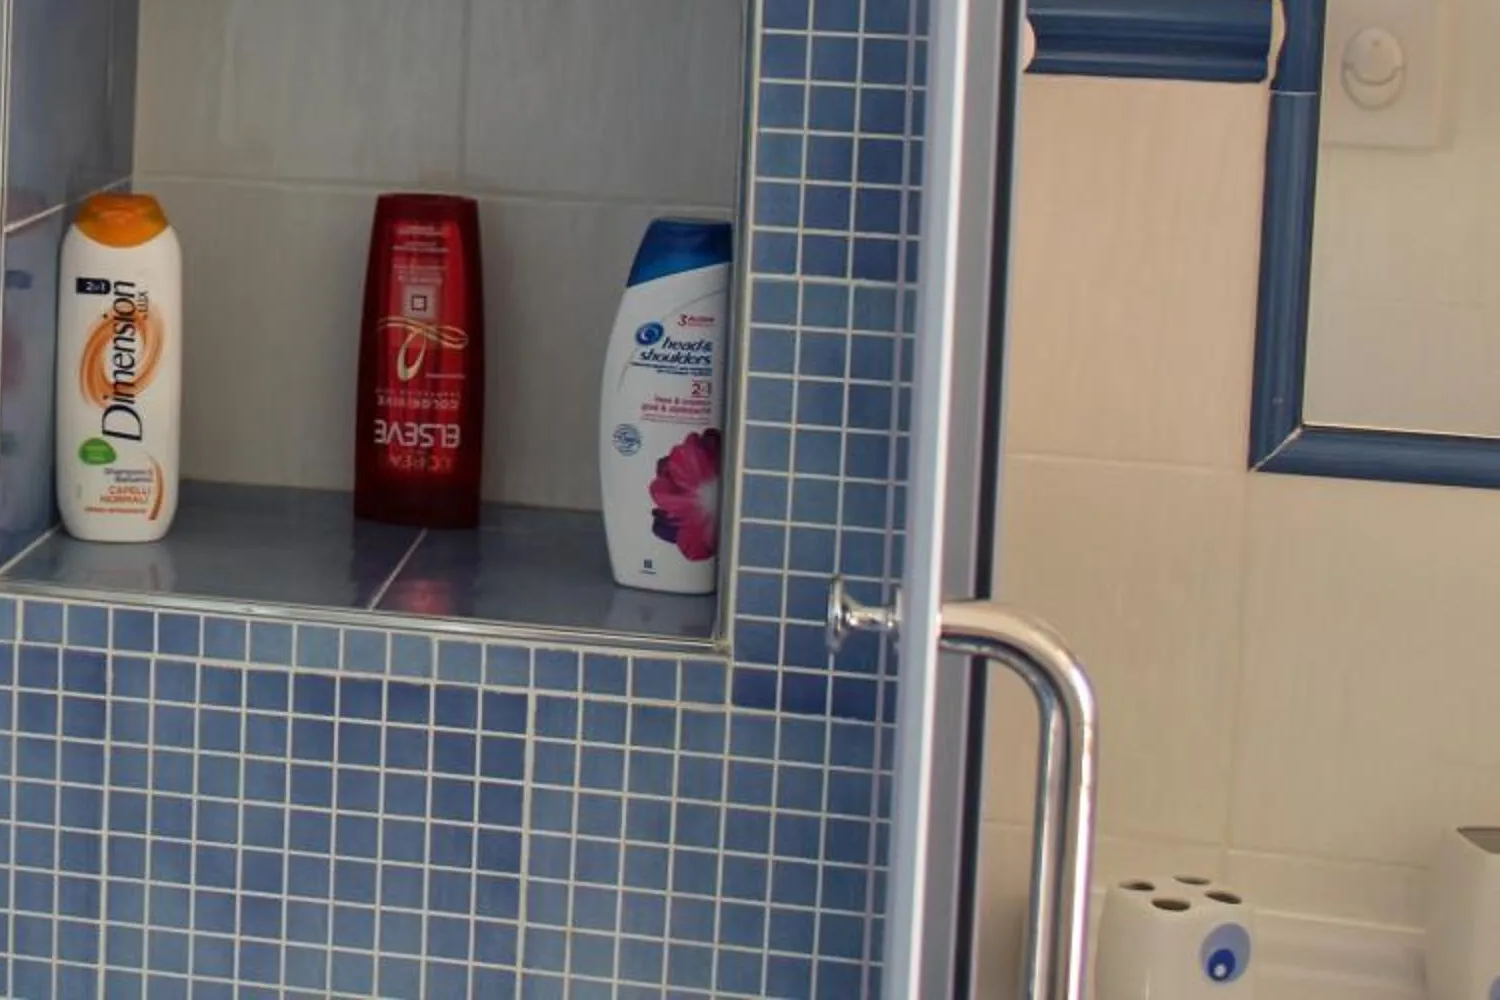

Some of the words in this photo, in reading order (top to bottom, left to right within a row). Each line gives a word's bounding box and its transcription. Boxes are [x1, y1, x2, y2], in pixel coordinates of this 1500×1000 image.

[101, 280, 142, 441] Dimension
[640, 349, 712, 365] shoulders
[373, 419, 461, 448] ELSEVE
